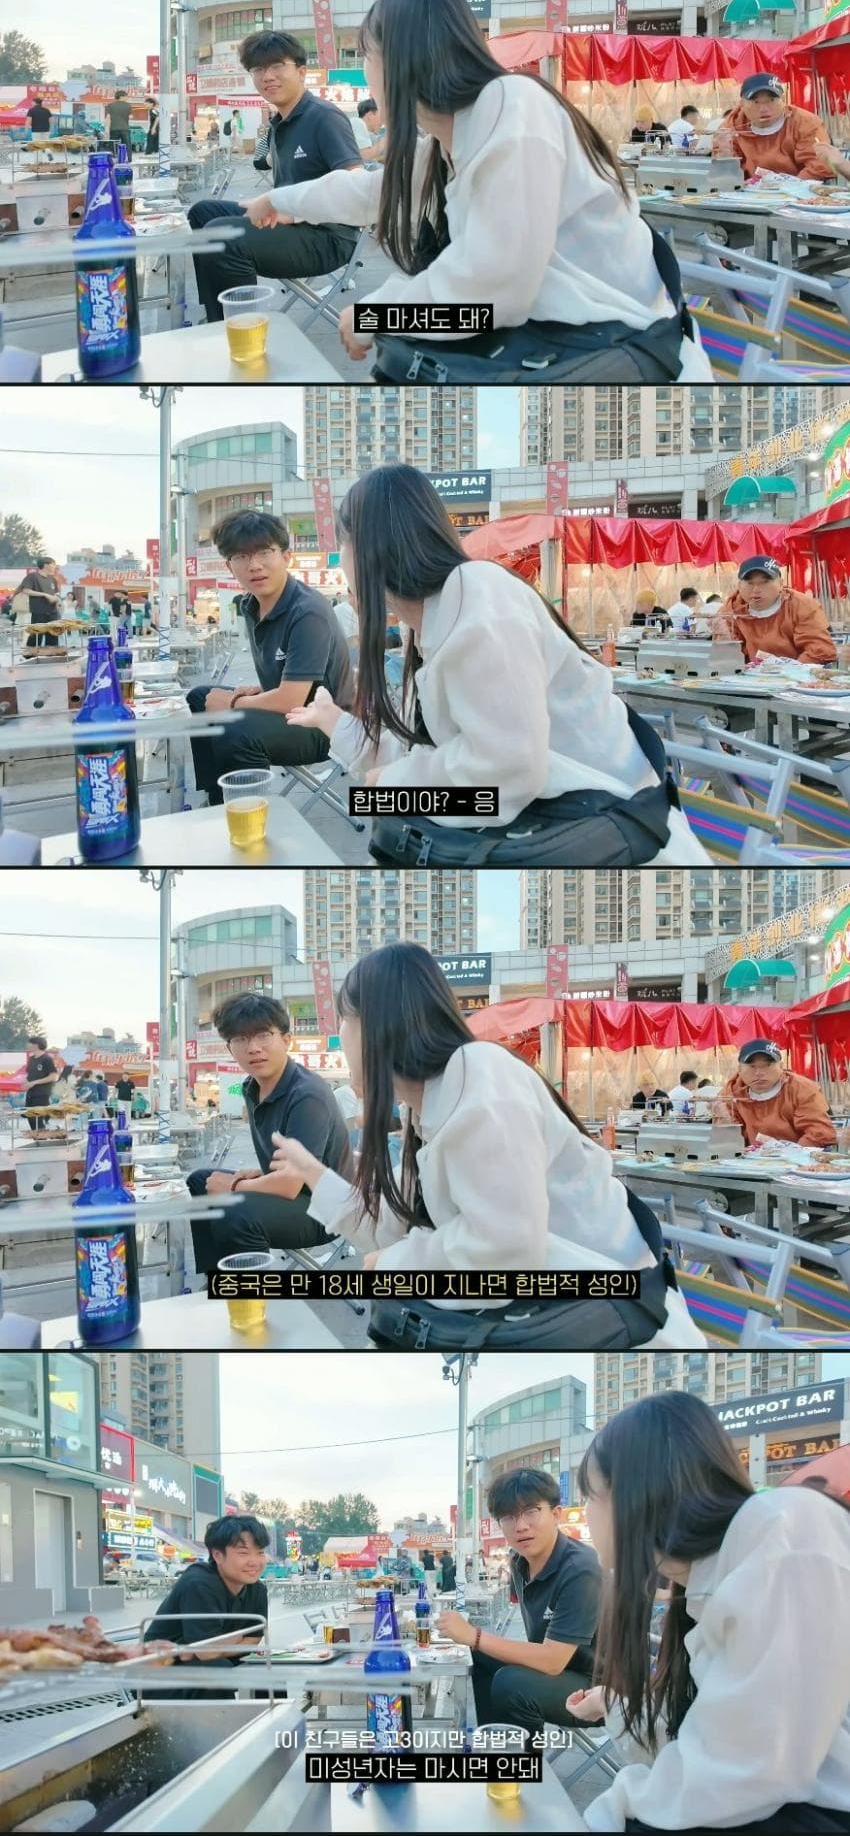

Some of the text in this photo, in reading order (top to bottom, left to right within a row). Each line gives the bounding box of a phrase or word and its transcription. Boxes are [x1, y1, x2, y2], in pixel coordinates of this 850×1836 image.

[462, 476, 486, 486] BAR
[462, 959, 486, 970] BAR
[796, 1389, 836, 1407] BAR
